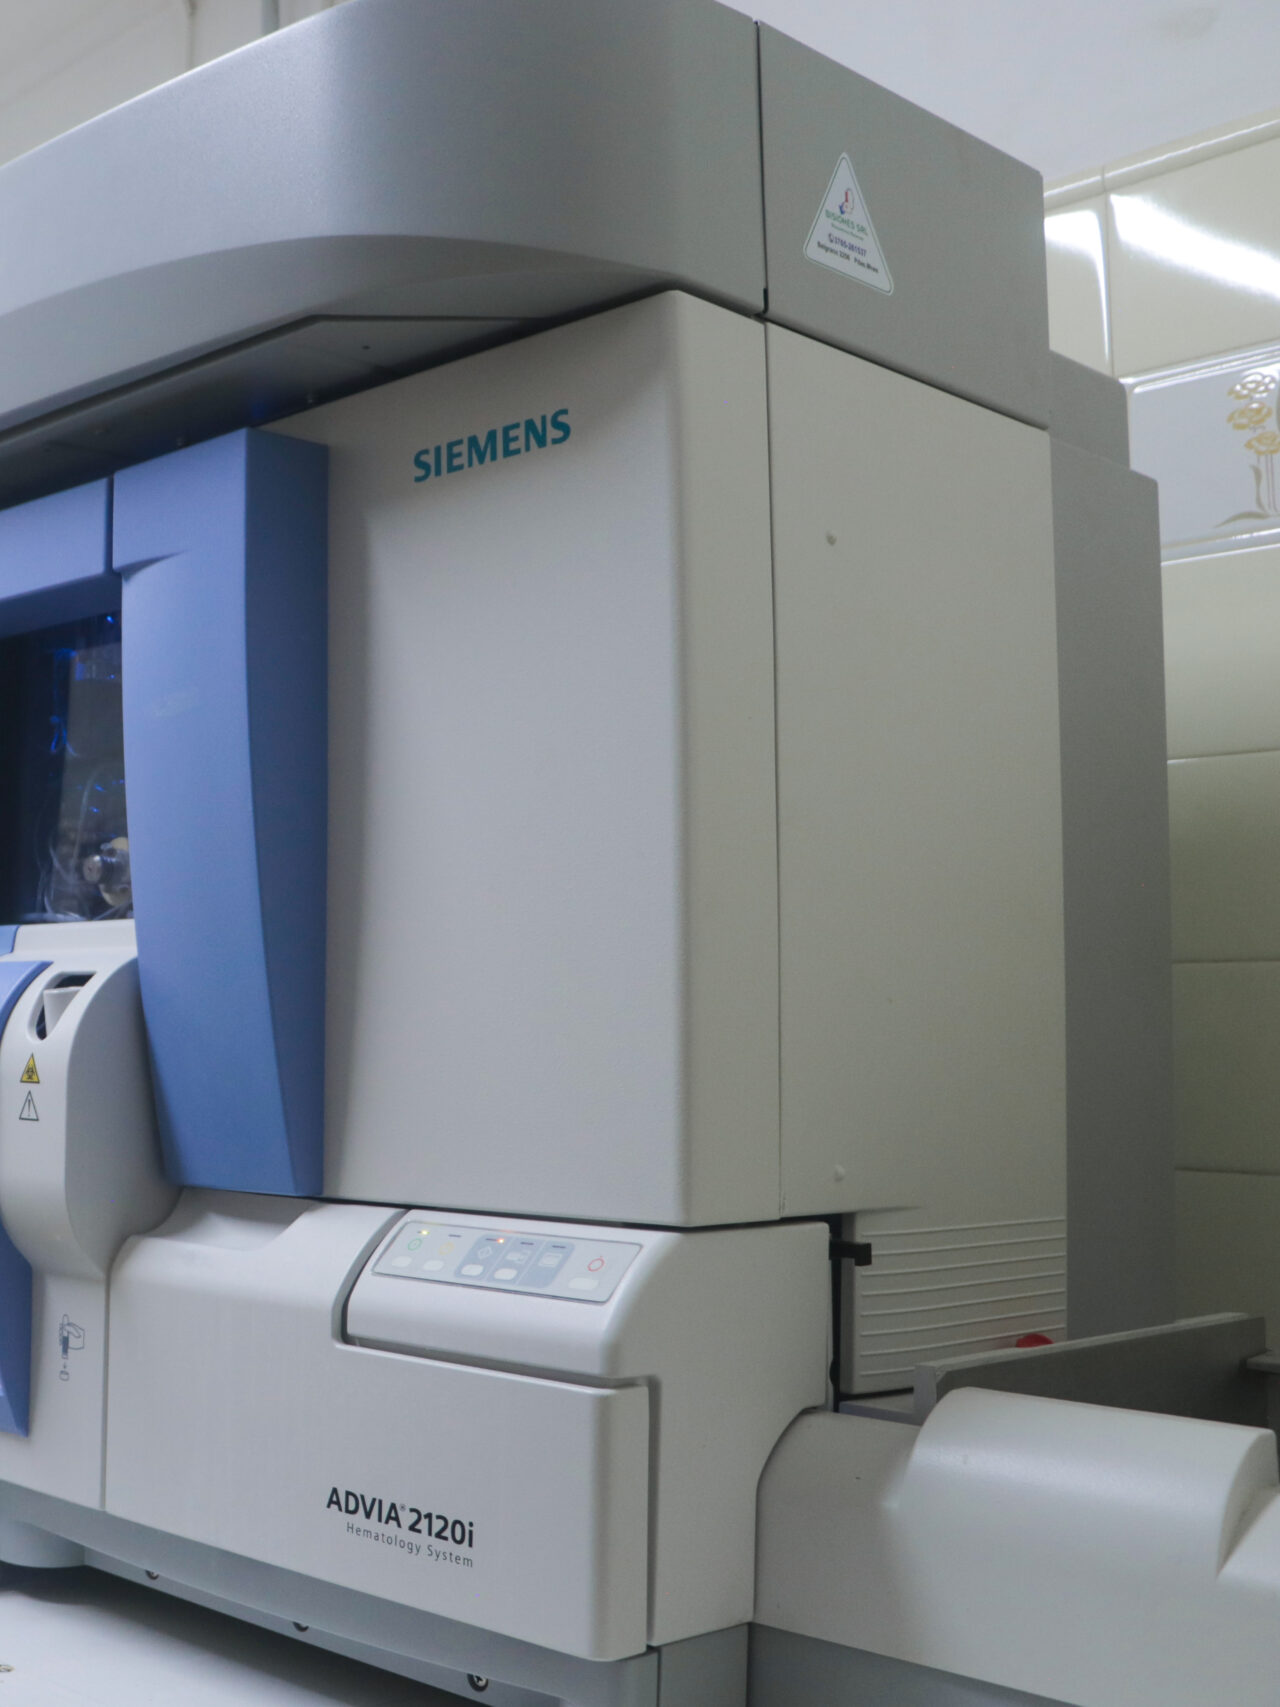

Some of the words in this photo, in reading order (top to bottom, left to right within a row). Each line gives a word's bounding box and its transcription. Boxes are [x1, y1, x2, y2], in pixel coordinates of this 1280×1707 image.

[413, 408, 571, 483] SIEMENS
[346, 1521, 421, 1556] Hematology
[427, 1544, 473, 1568] System
[408, 1507, 474, 1548] 2120i
